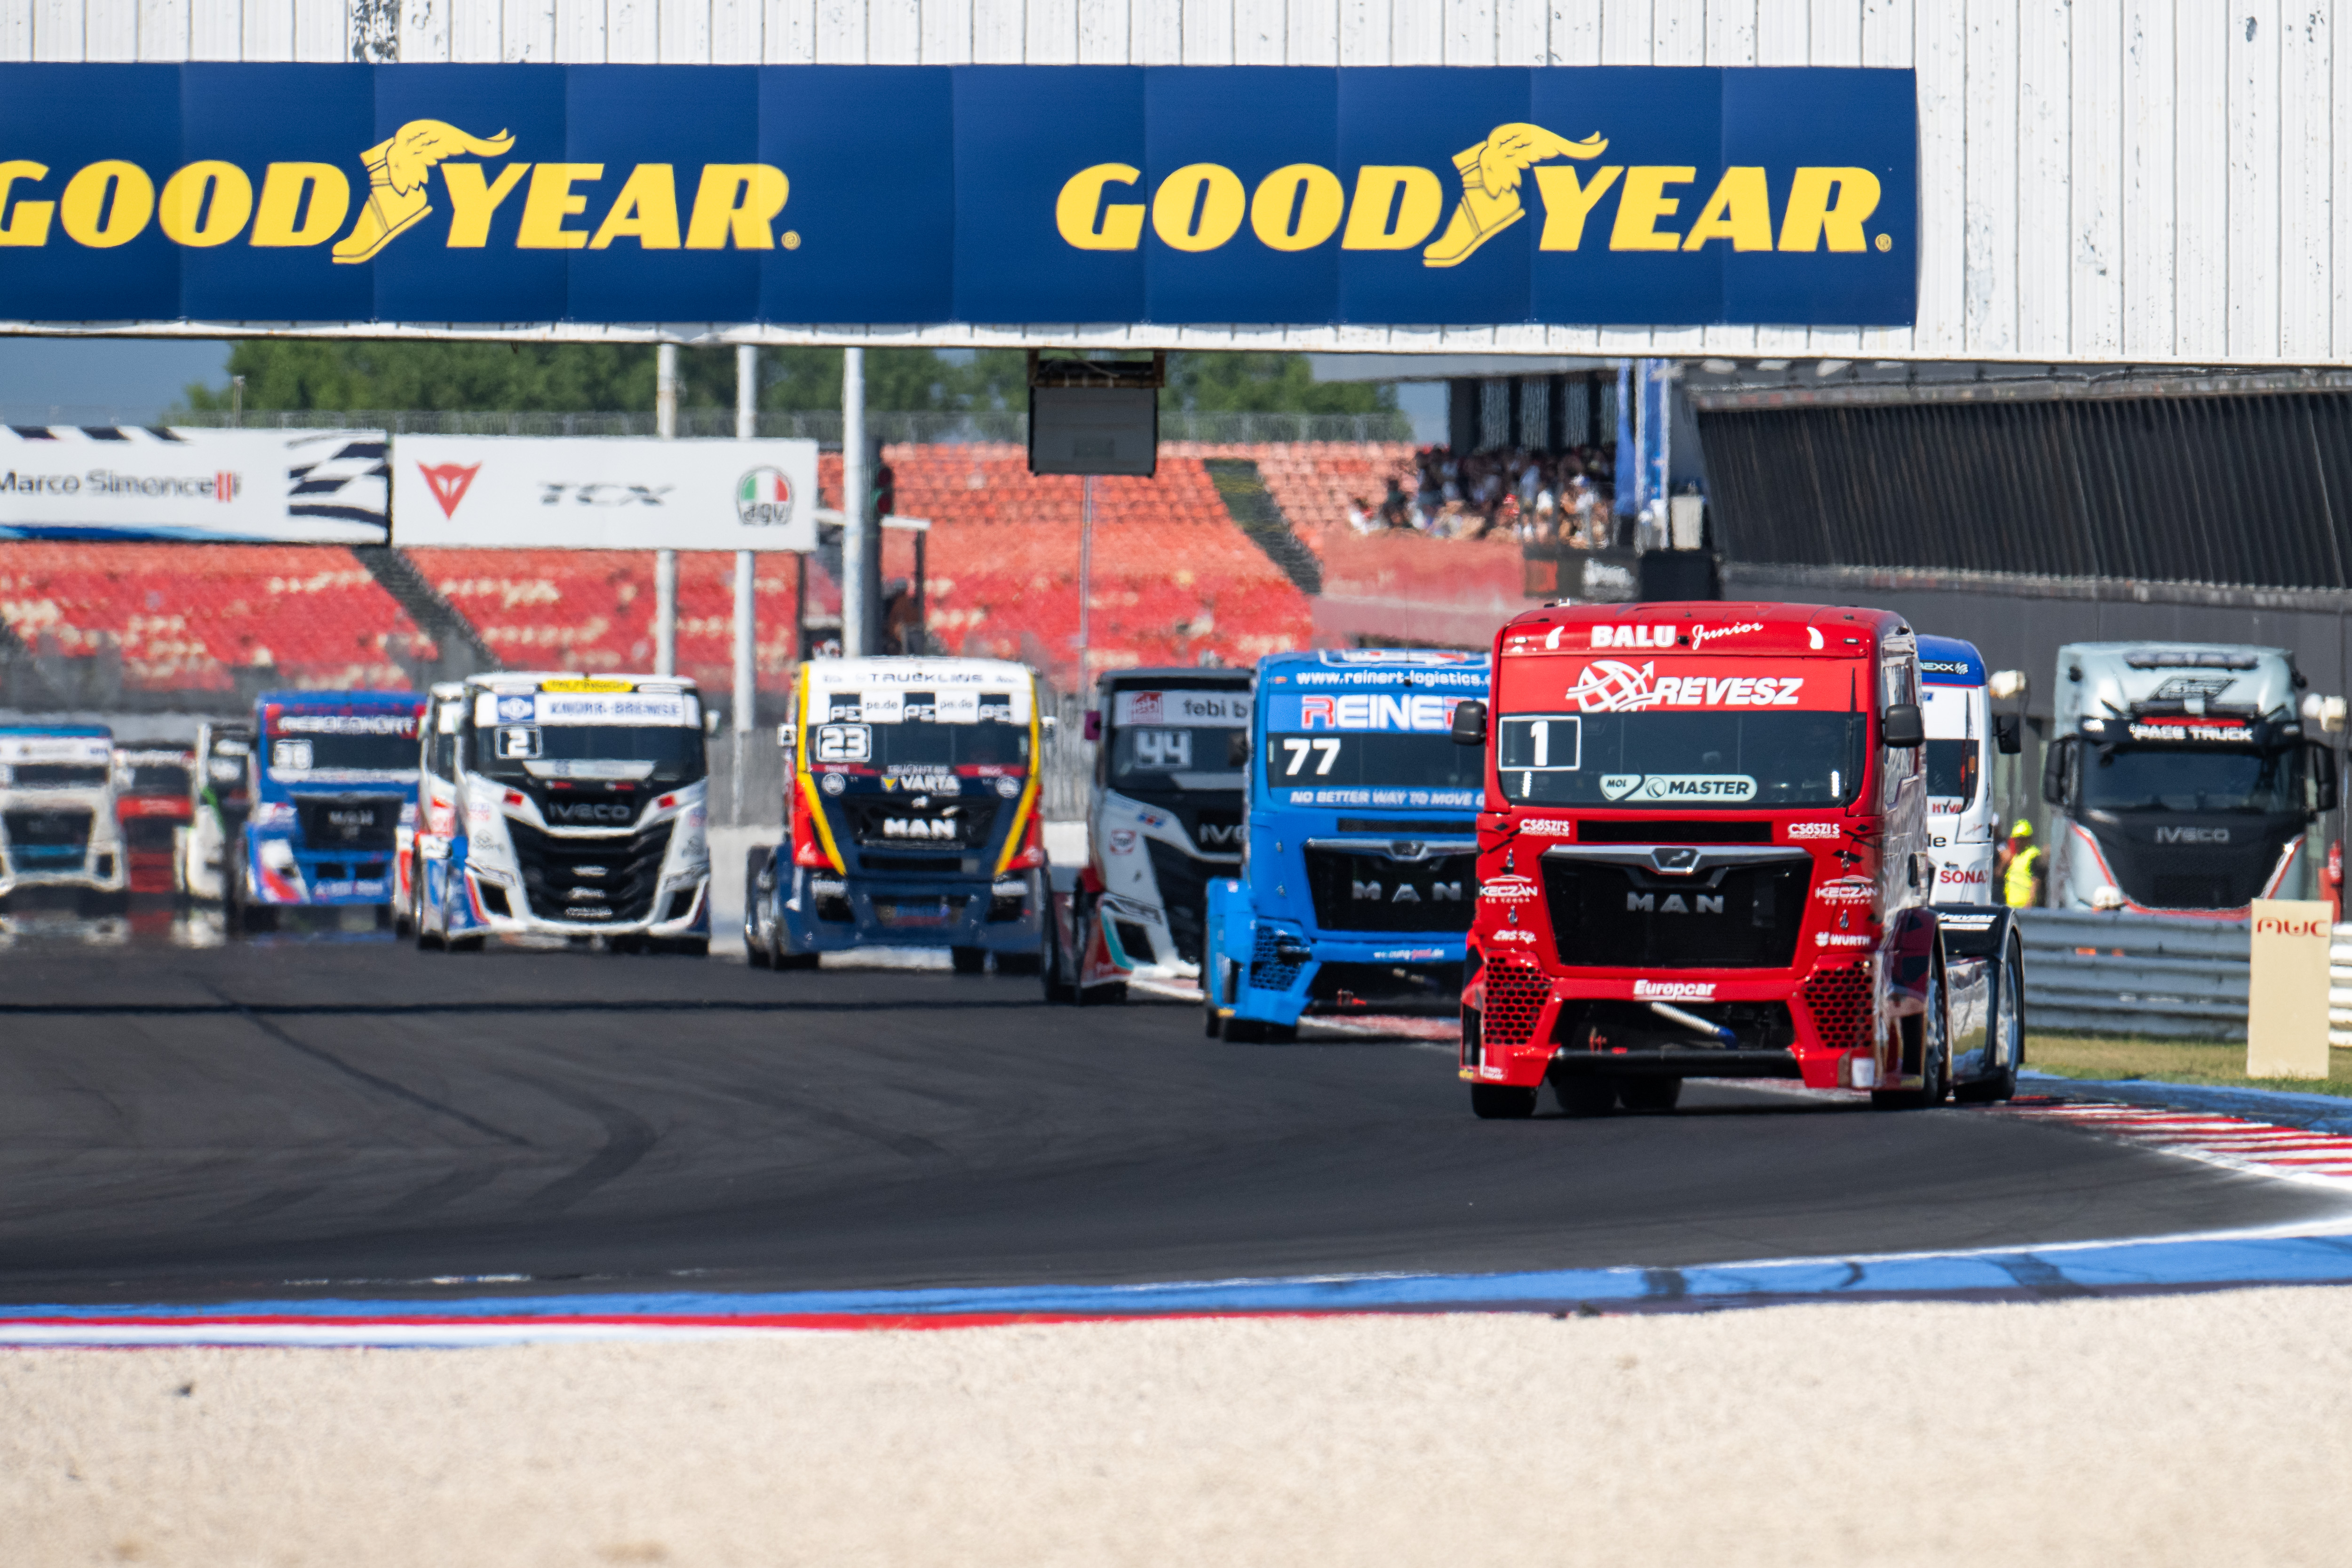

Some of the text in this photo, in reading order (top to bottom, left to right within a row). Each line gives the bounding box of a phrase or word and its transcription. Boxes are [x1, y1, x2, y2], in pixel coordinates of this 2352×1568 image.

[0, 471, 80, 493] Marco
[539, 483, 675, 506] TCX
[1591, 621, 1764, 650] BALU Junior
[1652, 677, 1804, 705] REVESZ
[866, 701, 898, 710] pe.de
[1184, 698, 1226, 717] febi
[507, 728, 529, 756] 2
[821, 727, 866, 757] 23
[1530, 720, 1549, 767] 1
[2189, 725, 2253, 741] TRUCK
[1137, 731, 1190, 764] 44
[1284, 738, 1341, 775] 77
[900, 775, 961, 791] VARTA
[1606, 779, 1627, 788] MOL
[1668, 781, 1750, 796] MASTER
[1290, 791, 1313, 804] NO
[1316, 791, 1369, 804] BETTER
[1373, 791, 1407, 805] WAY
[1409, 792, 1428, 805] TO
[1431, 793, 1473, 806] MOVE
[548, 802, 631, 821] IVECO
[884, 817, 956, 840] MAN
[2156, 826, 2230, 843] IVECO
[1940, 870, 1988, 884] SONA
[1352, 880, 1462, 903] MAN
[1627, 892, 1724, 914] MAN
[1633, 979, 1716, 1000] Europcar
